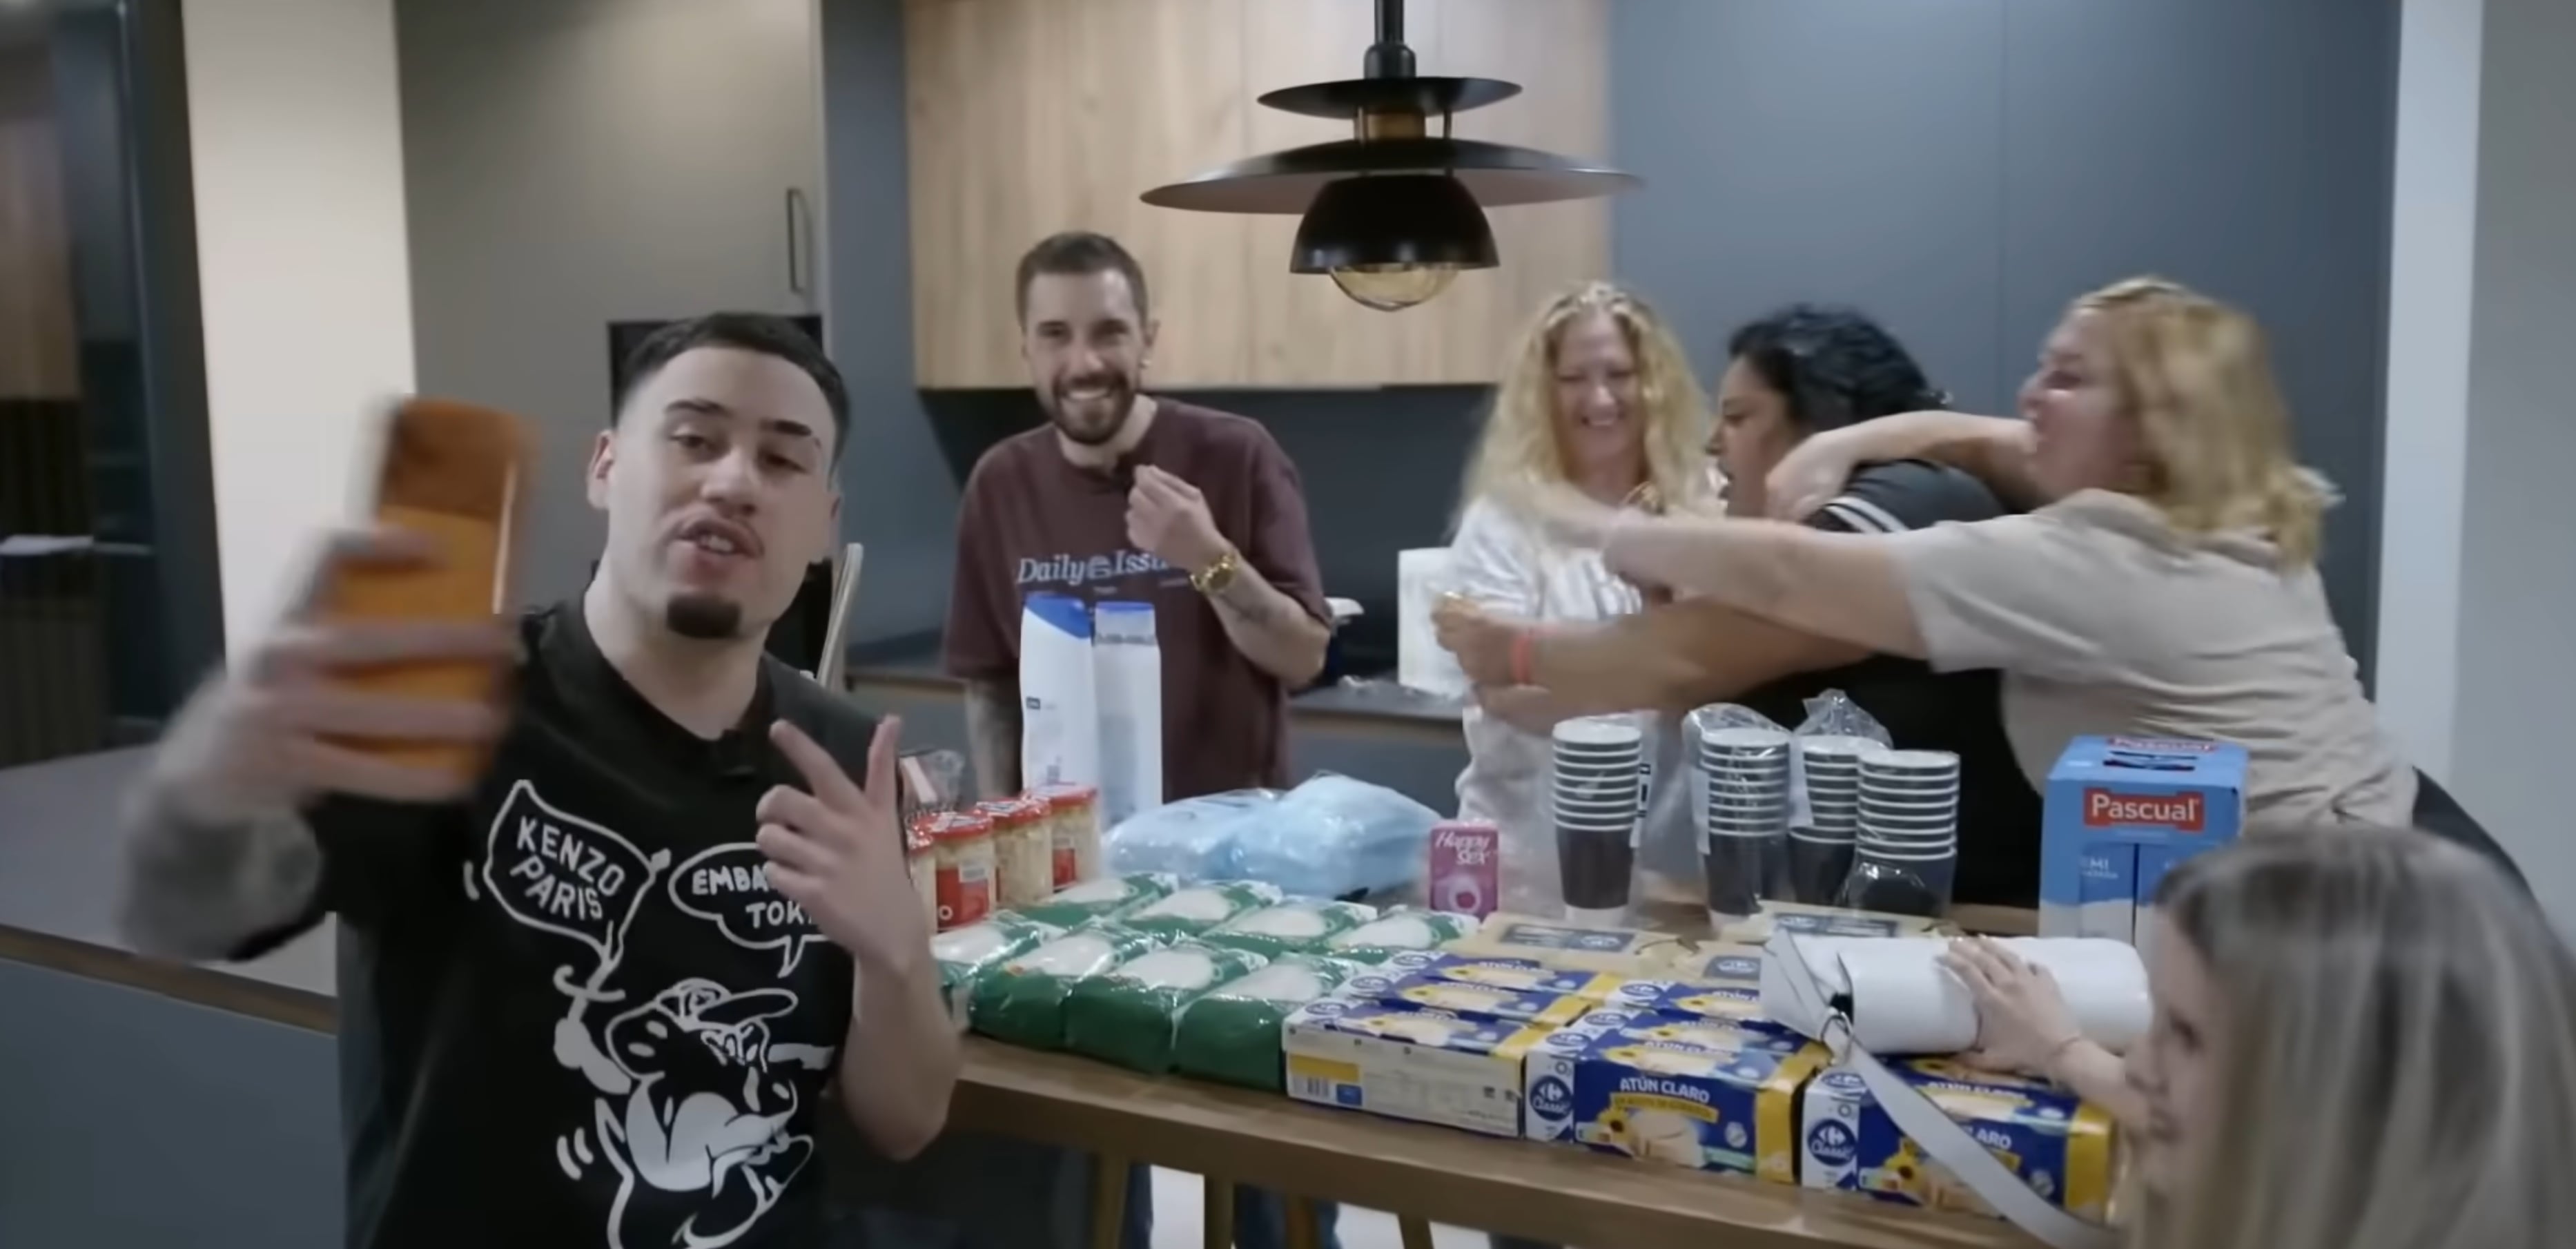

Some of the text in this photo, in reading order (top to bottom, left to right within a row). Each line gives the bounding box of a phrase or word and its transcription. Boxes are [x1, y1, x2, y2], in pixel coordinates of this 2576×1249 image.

[1018, 554, 1085, 585] Daily
[1115, 550, 1170, 574] Issu
[2091, 793, 2195, 821] Pascual
[516, 815, 626, 896] KENZO
[509, 855, 603, 920] PARIS
[692, 864, 769, 895] EMBA
[745, 900, 812, 929] TOK
[1619, 1075, 1710, 1104] ATÚN CLARO
